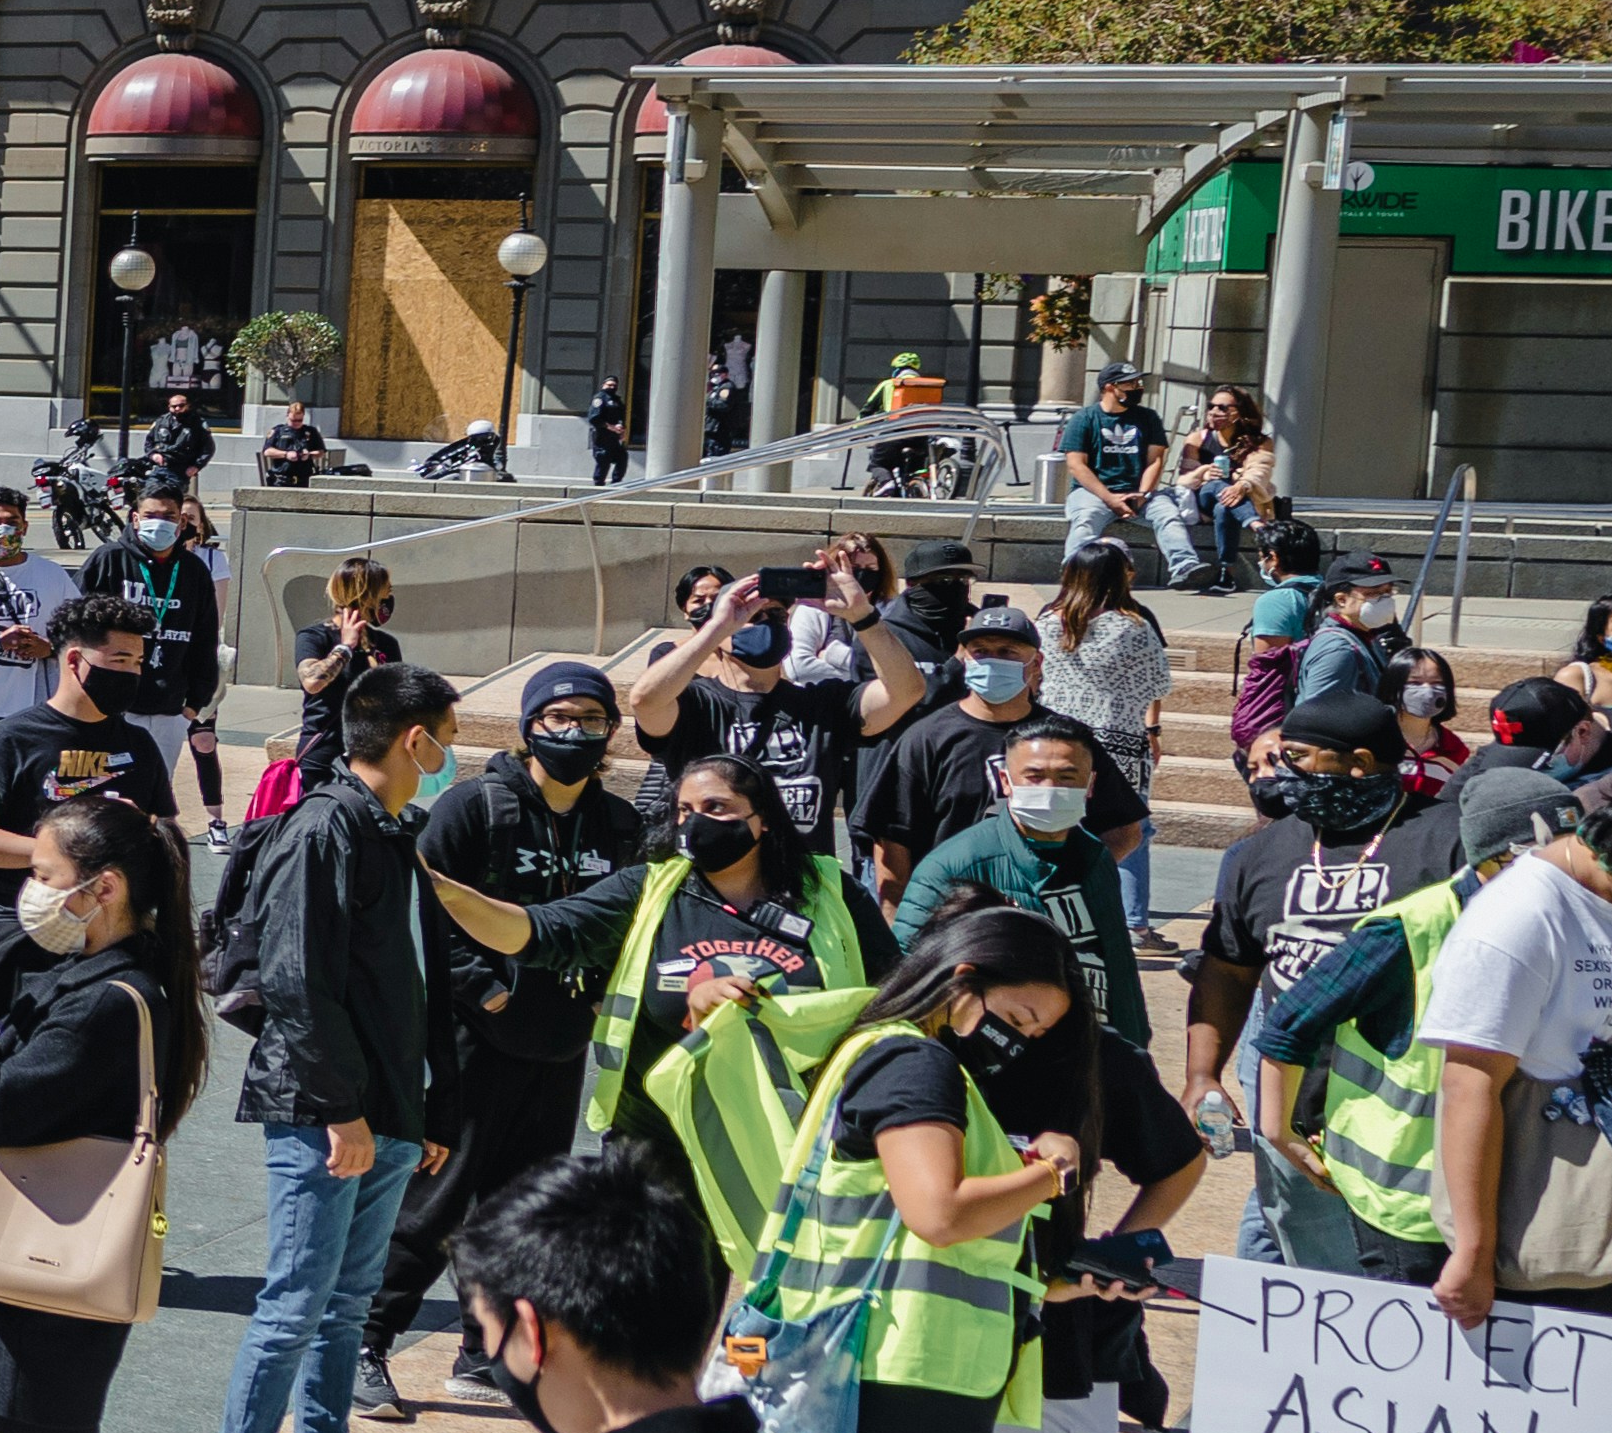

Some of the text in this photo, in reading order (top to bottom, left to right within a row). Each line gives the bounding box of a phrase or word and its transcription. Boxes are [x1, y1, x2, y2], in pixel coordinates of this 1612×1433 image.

[57, 749, 111, 778] NIKE
[679, 938, 805, 975] TOGETHER
[1261, 1276, 1612, 1407] PROTECT
